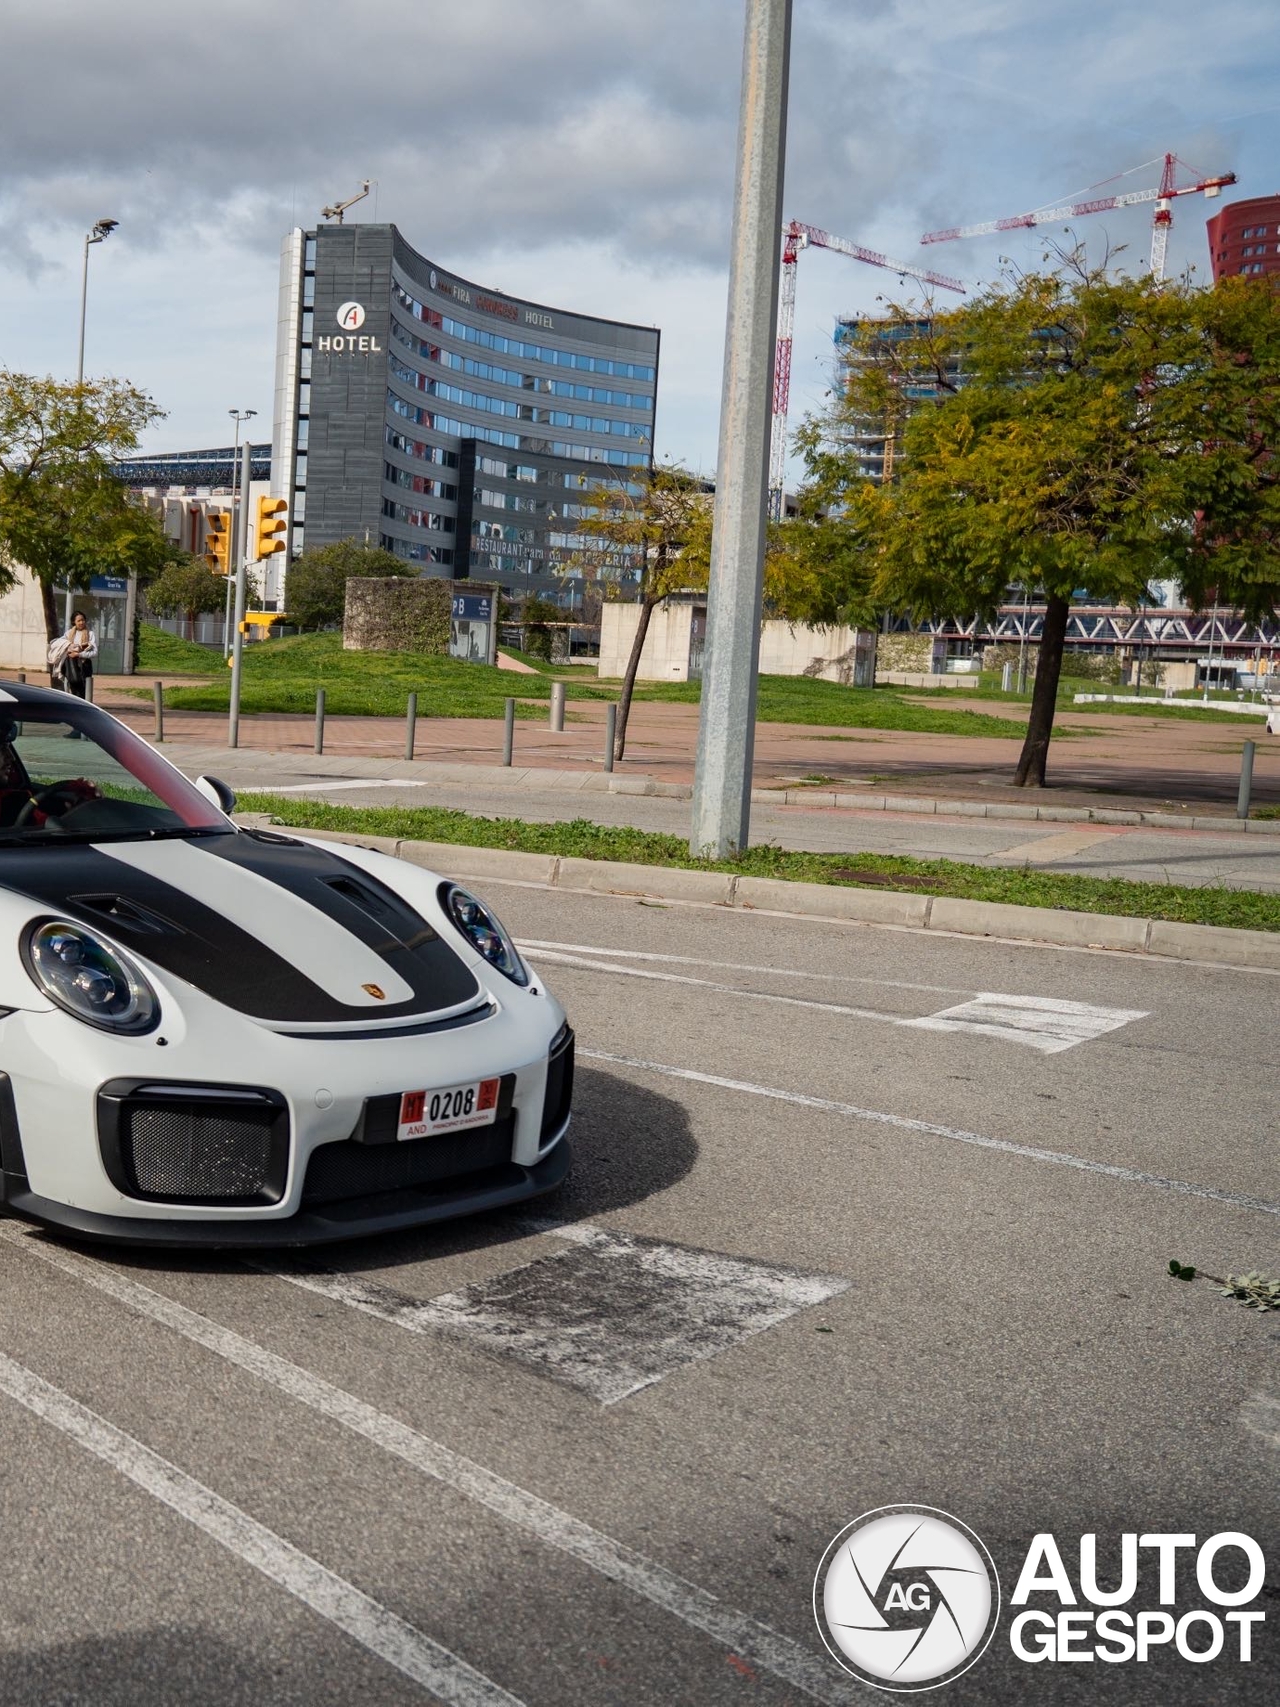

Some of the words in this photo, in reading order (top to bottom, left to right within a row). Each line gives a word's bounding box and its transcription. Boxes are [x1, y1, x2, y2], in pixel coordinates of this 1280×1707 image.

[453, 286, 470, 304] FIRA
[525, 310, 554, 329] HOTEL
[318, 336, 381, 351] HOTEL
[476, 537, 523, 556] RESTAURANT
[429, 1088, 475, 1121] 0208
[406, 1124, 427, 1136] AND
